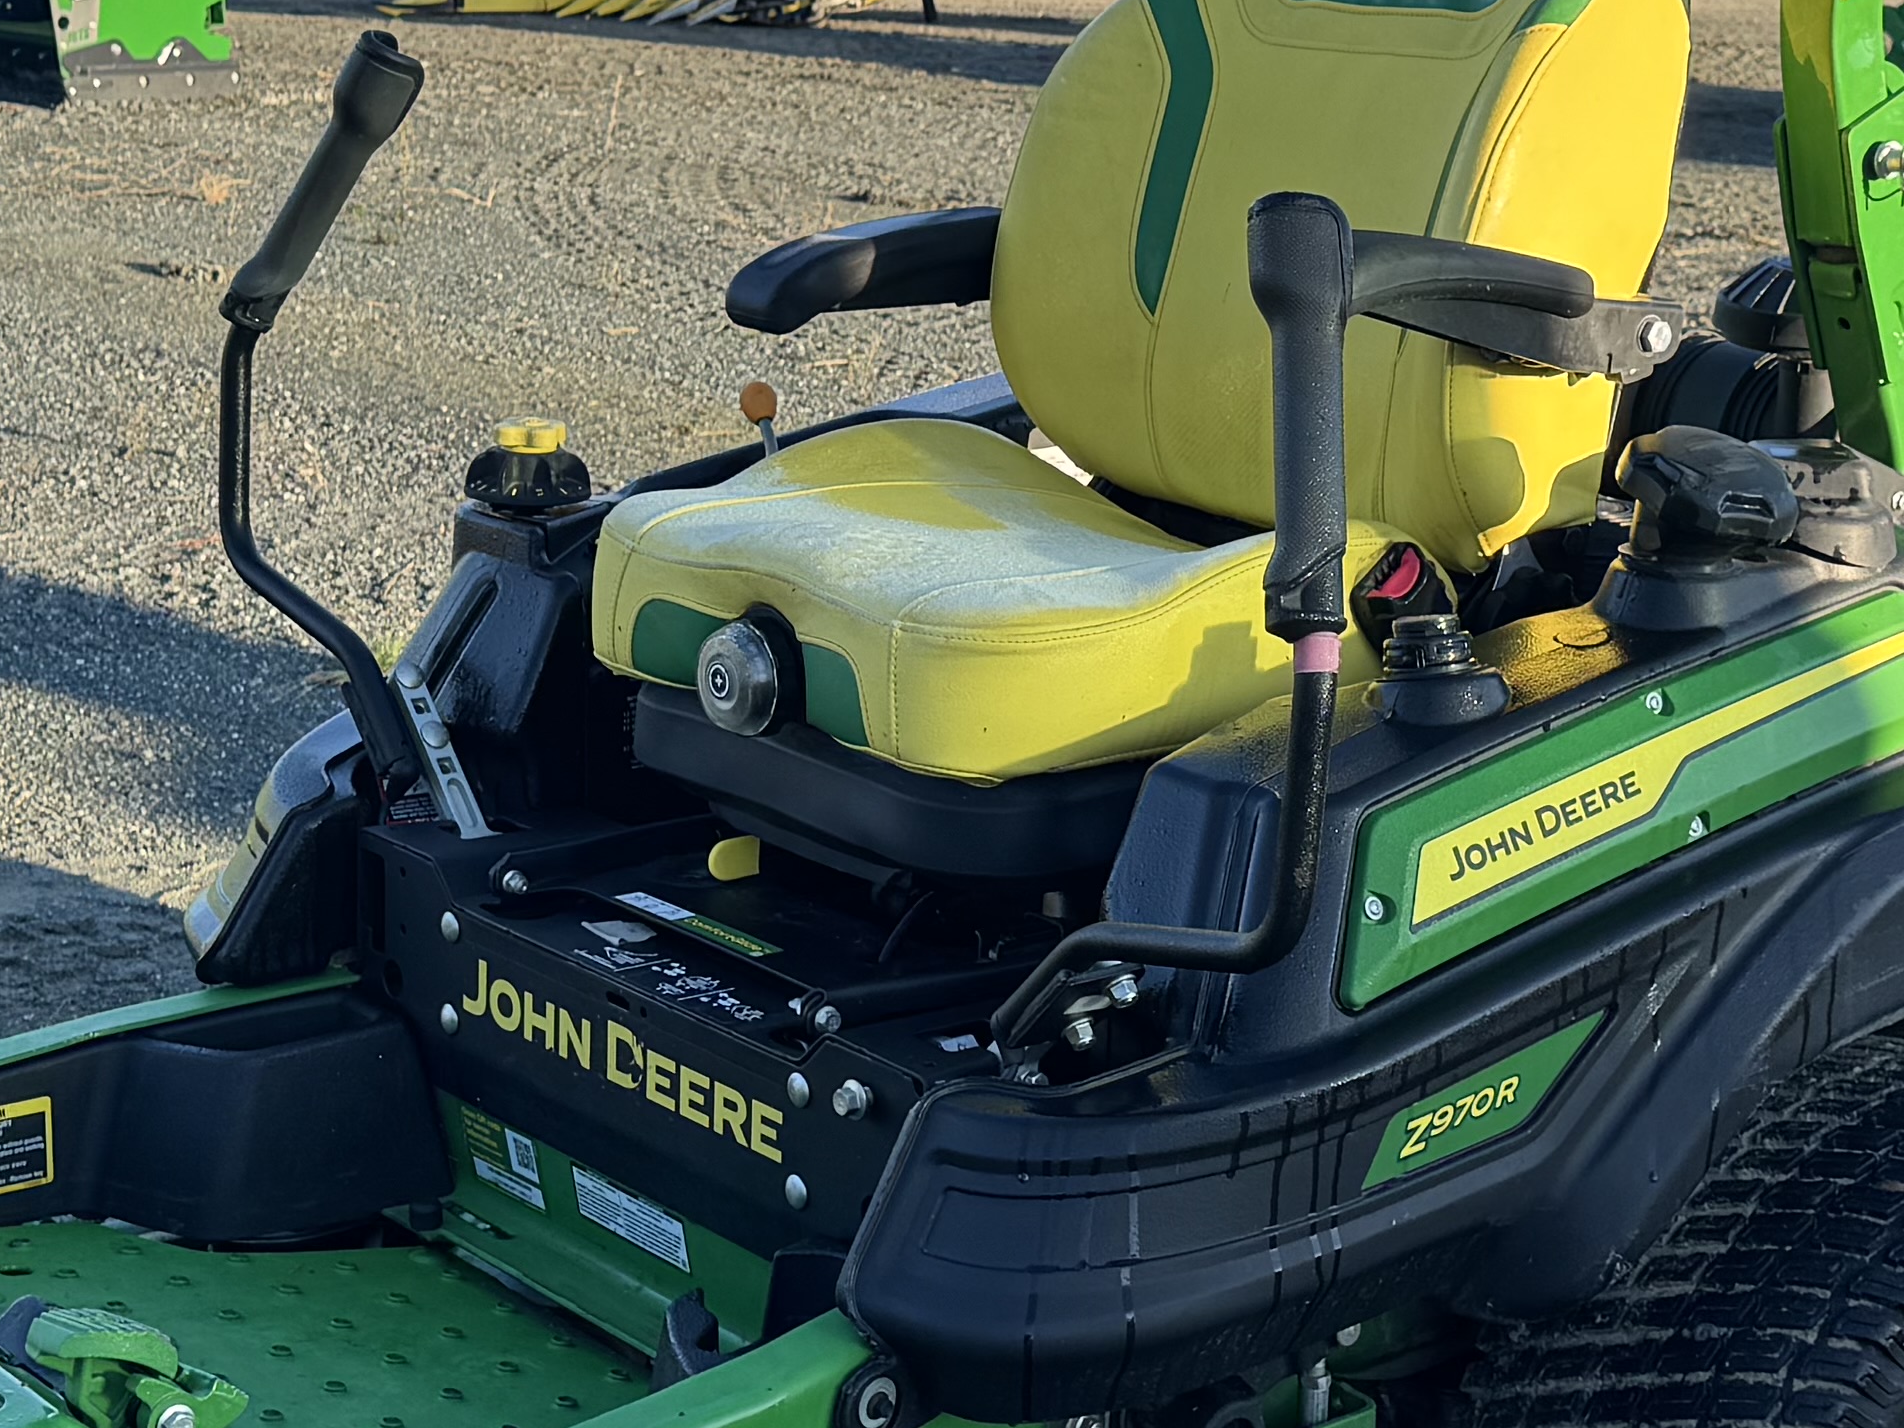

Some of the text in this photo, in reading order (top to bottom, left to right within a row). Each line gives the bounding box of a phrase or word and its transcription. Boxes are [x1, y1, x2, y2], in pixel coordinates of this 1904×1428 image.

[1449, 769, 1643, 883] JOHN DEERE
[462, 959, 592, 1071] JOHN
[606, 1019, 784, 1165] DEERE
[1399, 1074, 1520, 1160] Z970R
